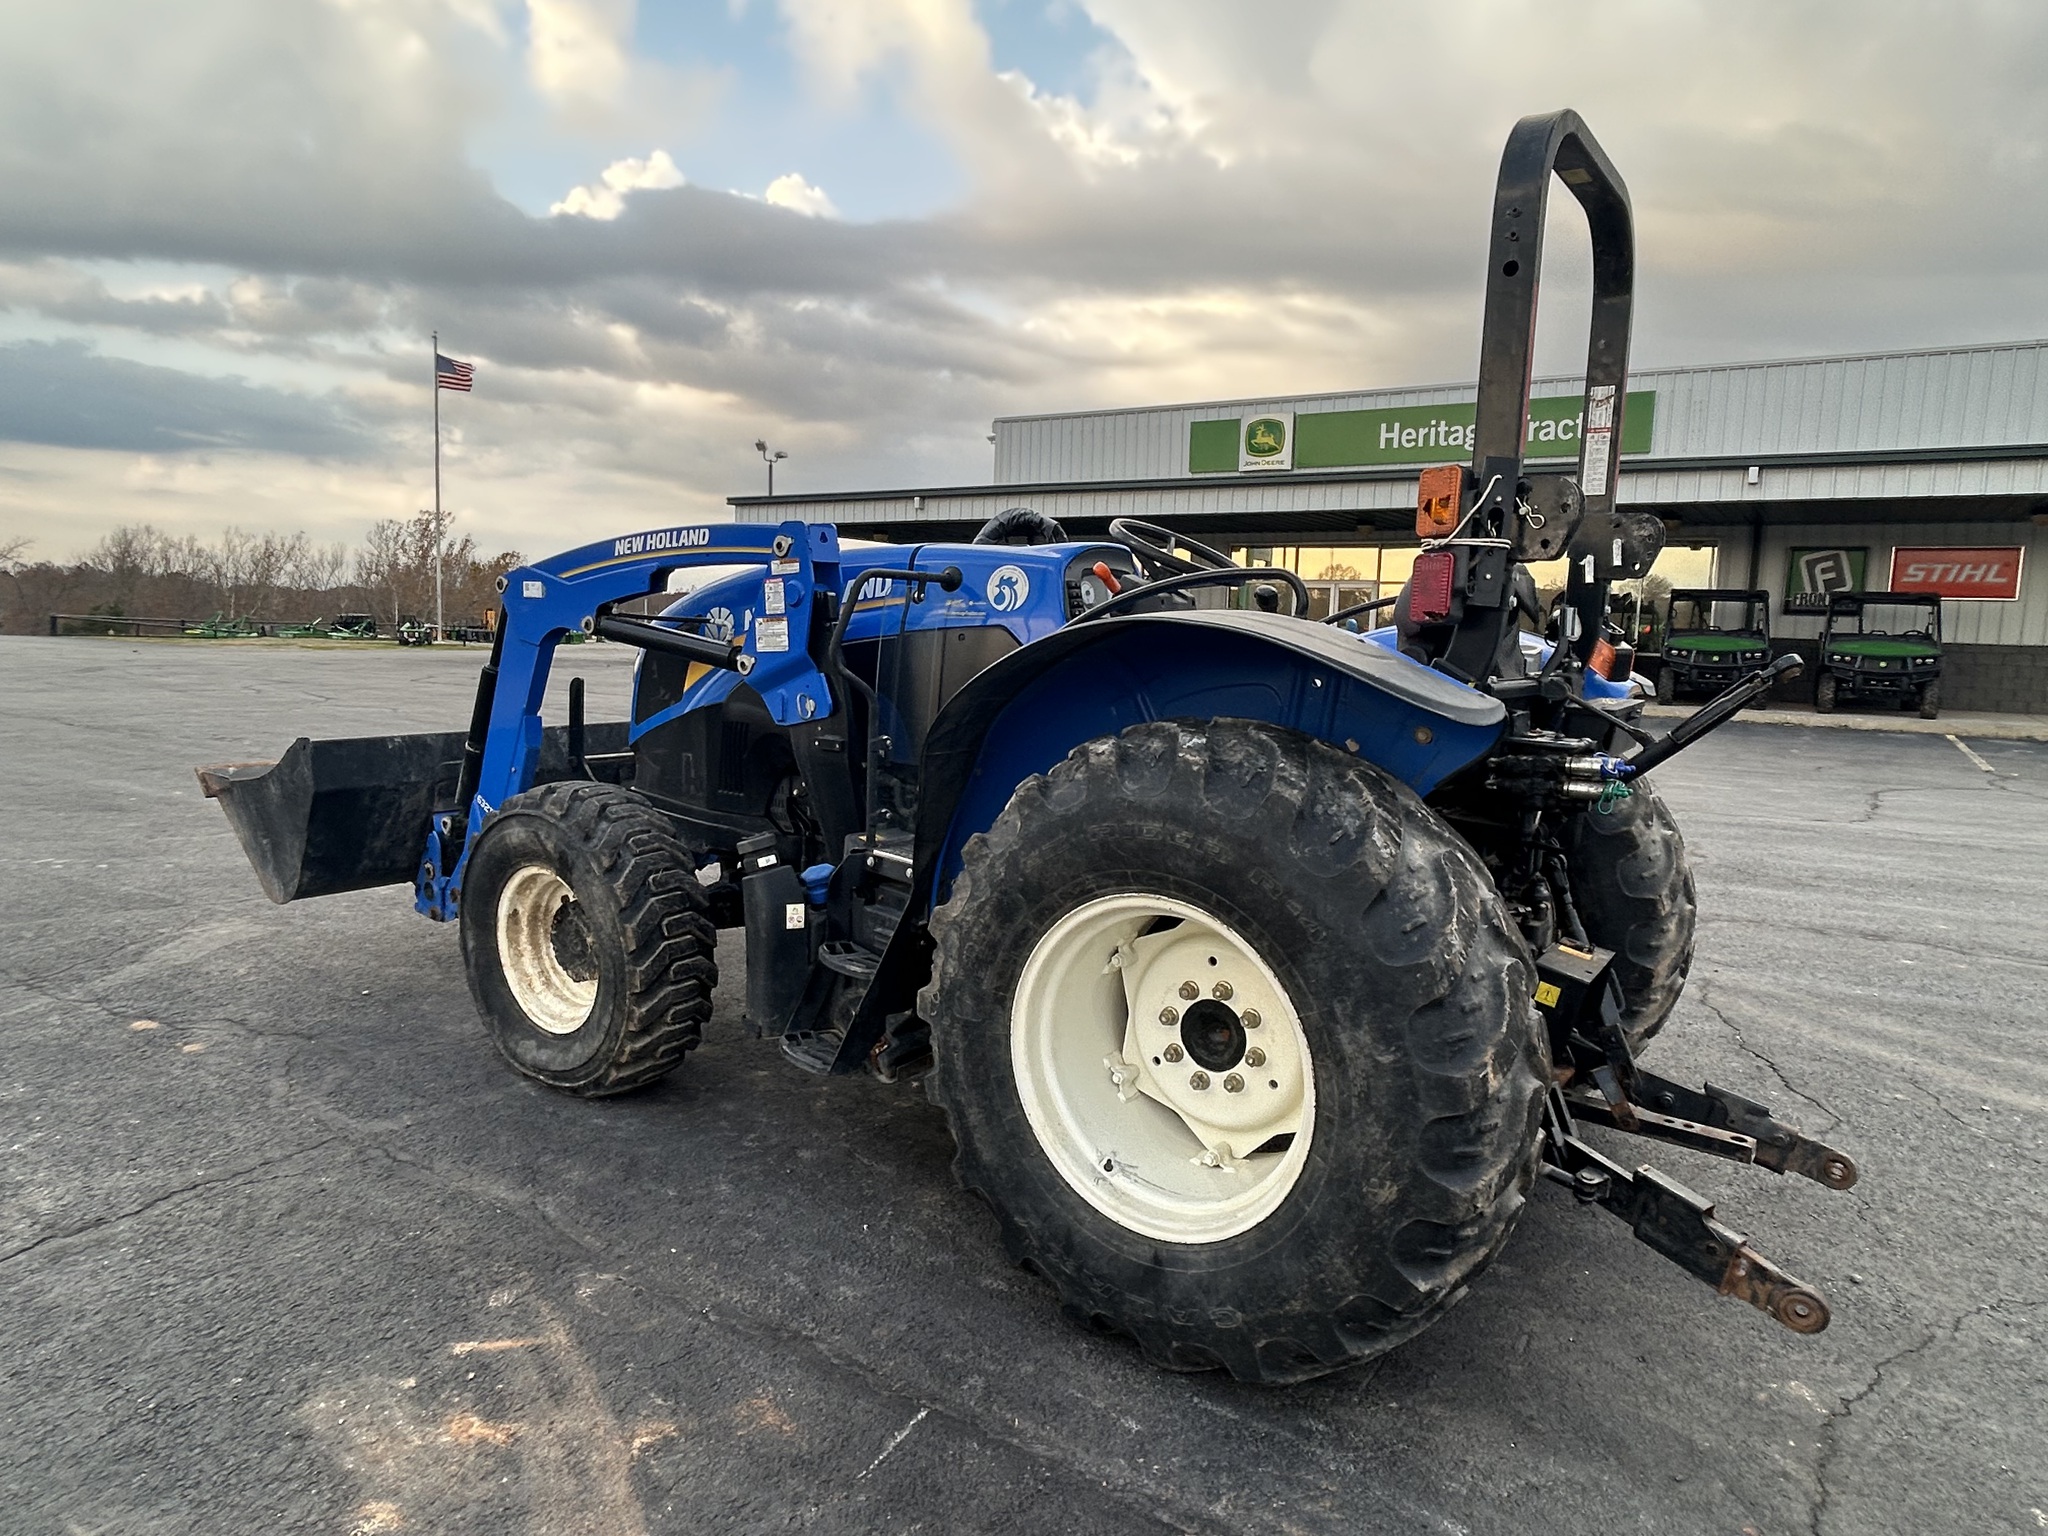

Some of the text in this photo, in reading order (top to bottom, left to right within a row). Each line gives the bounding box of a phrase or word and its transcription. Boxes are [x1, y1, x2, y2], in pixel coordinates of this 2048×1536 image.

[1379, 419, 1476, 451] Heritag
[1243, 459, 1286, 468] JOHN DEERE
[614, 528, 711, 557] NEW HOLLAND
[1902, 563, 2009, 583] STIHL
